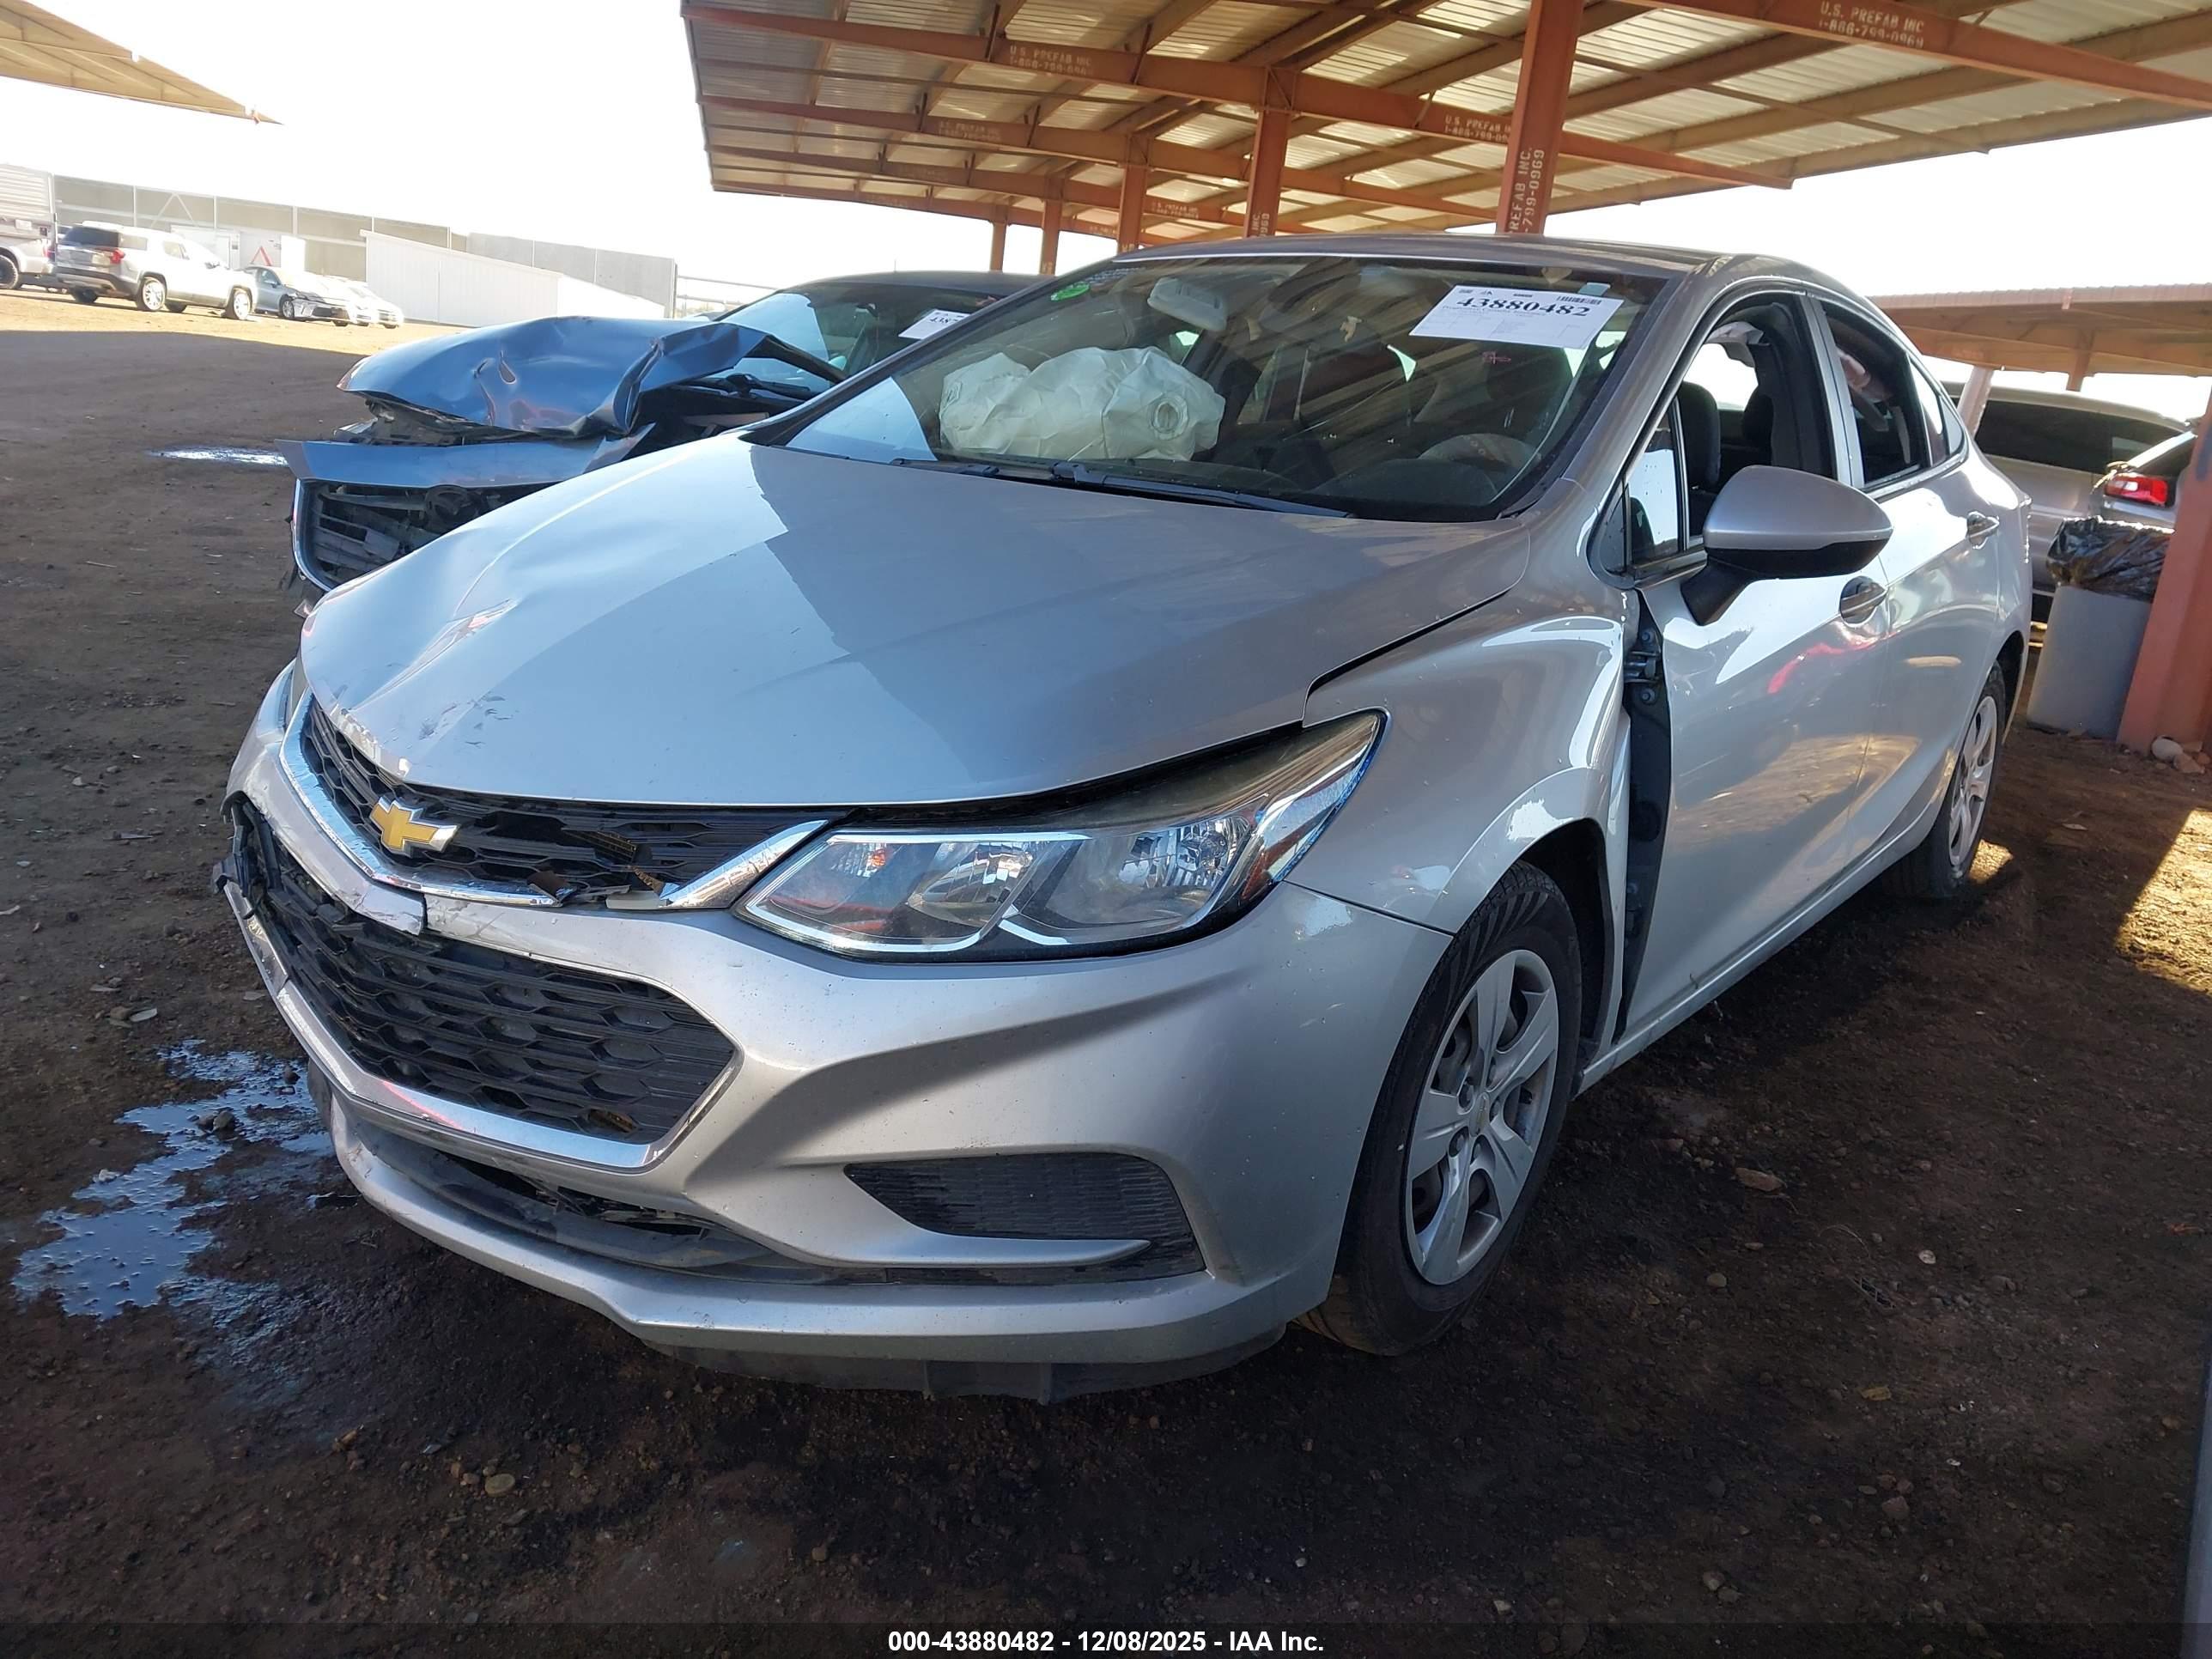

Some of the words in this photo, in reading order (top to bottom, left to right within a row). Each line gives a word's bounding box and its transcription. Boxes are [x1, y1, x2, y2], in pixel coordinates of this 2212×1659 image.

[1820, 1, 1844, 18] U.S.
[1850, 6, 1899, 28] PREFAB
[1509, 182, 1526, 233] REFAB
[1456, 296, 1590, 317] 43880482
